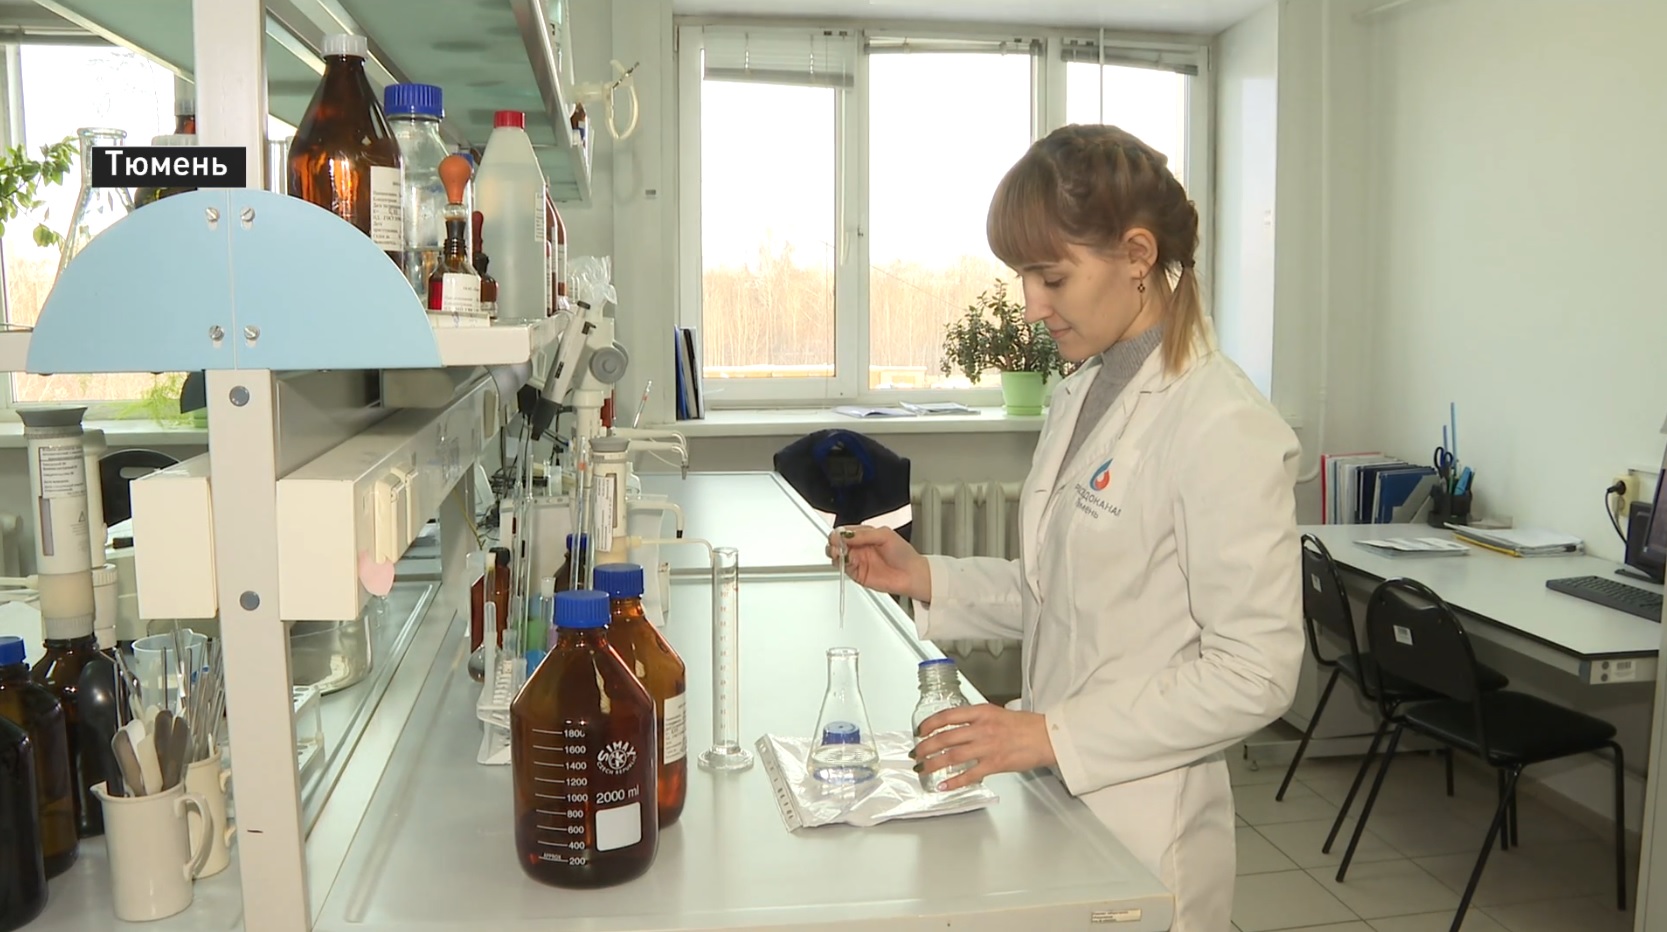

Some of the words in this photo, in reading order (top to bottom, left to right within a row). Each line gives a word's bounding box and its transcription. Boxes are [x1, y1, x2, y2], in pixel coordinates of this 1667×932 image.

[564, 745, 587, 754] 1600
[597, 740, 637, 762] SIMAX
[565, 761, 587, 770] 1400
[596, 760, 614, 775] CZECH
[566, 778, 588, 786] 1200
[566, 794, 589, 802] 1000
[596, 789, 625, 804] 2000
[628, 784, 640, 799] ml
[567, 810, 584, 818] 800
[567, 826, 584, 834] 600
[568, 841, 586, 850] 400
[569, 857, 586, 865] 200
